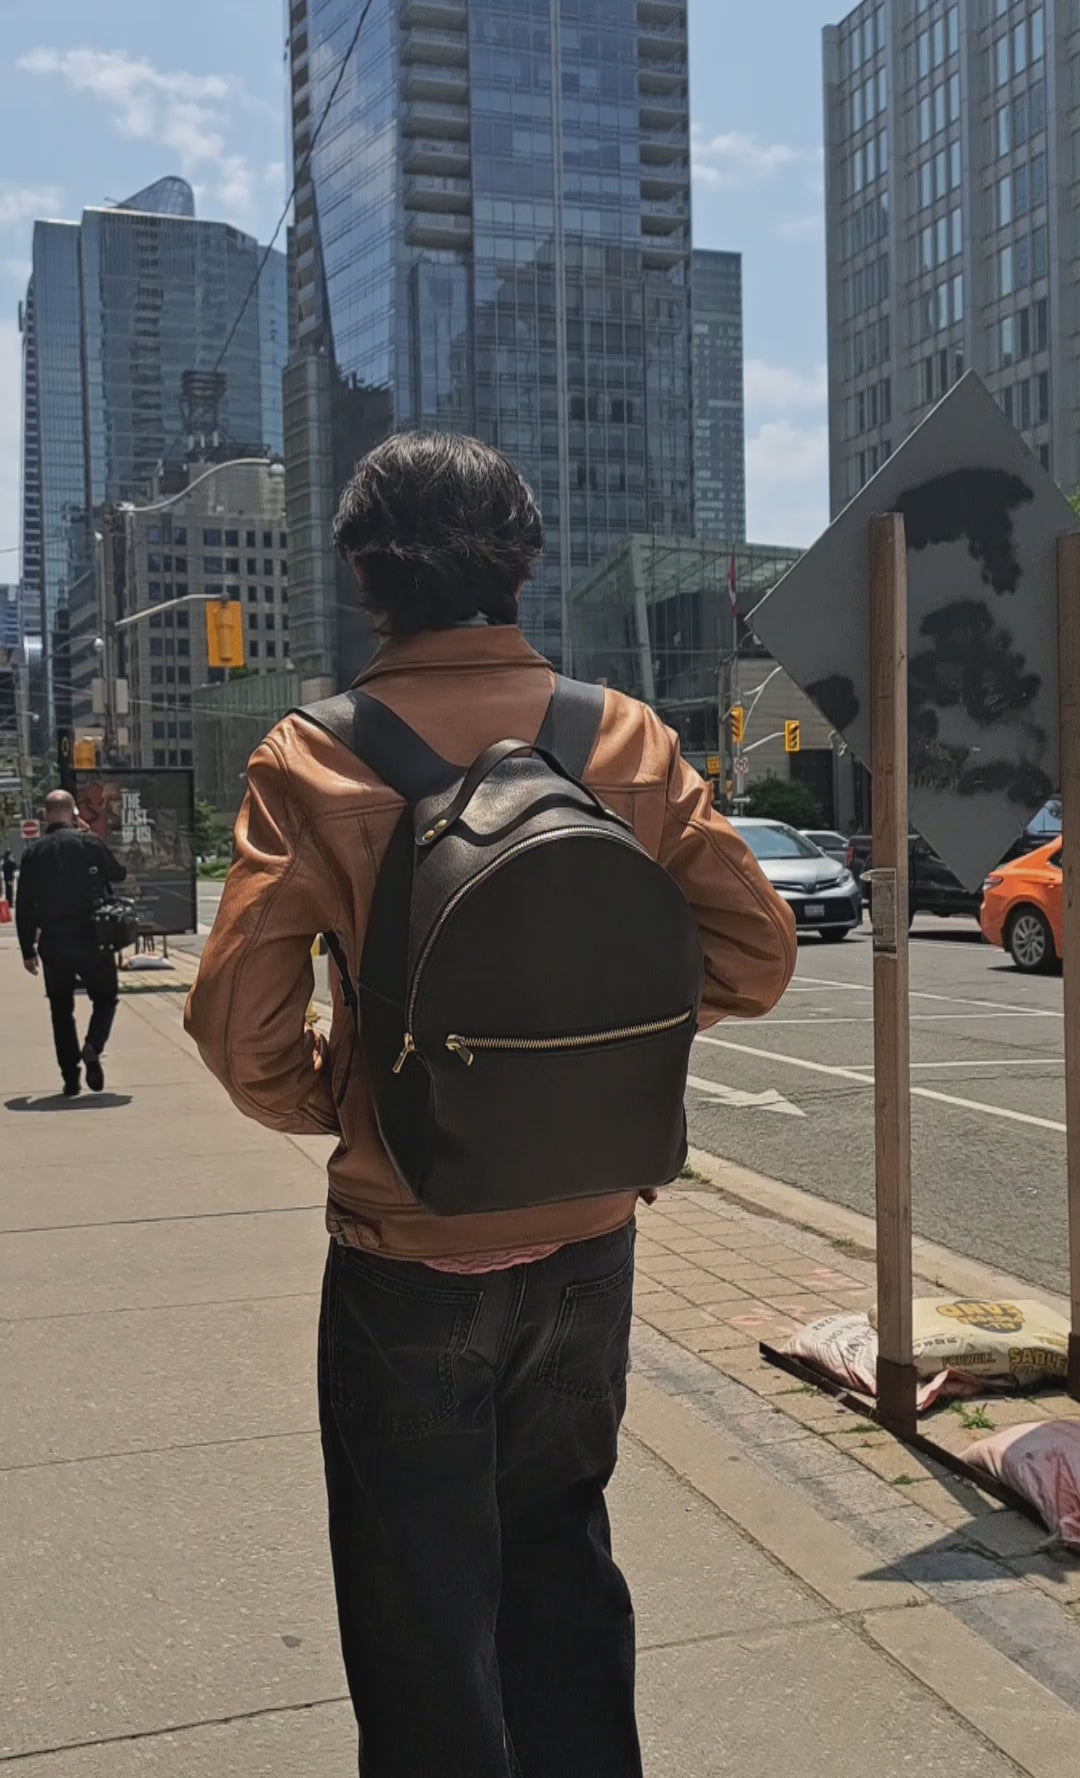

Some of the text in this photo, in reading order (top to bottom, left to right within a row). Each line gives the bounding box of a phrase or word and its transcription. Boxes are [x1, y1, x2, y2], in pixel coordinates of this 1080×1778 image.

[121, 793, 141, 808] THE
[121, 809, 148, 825] LAST
[122, 826, 152, 843] OF US
[1008, 1347, 1068, 1368] SABLE
